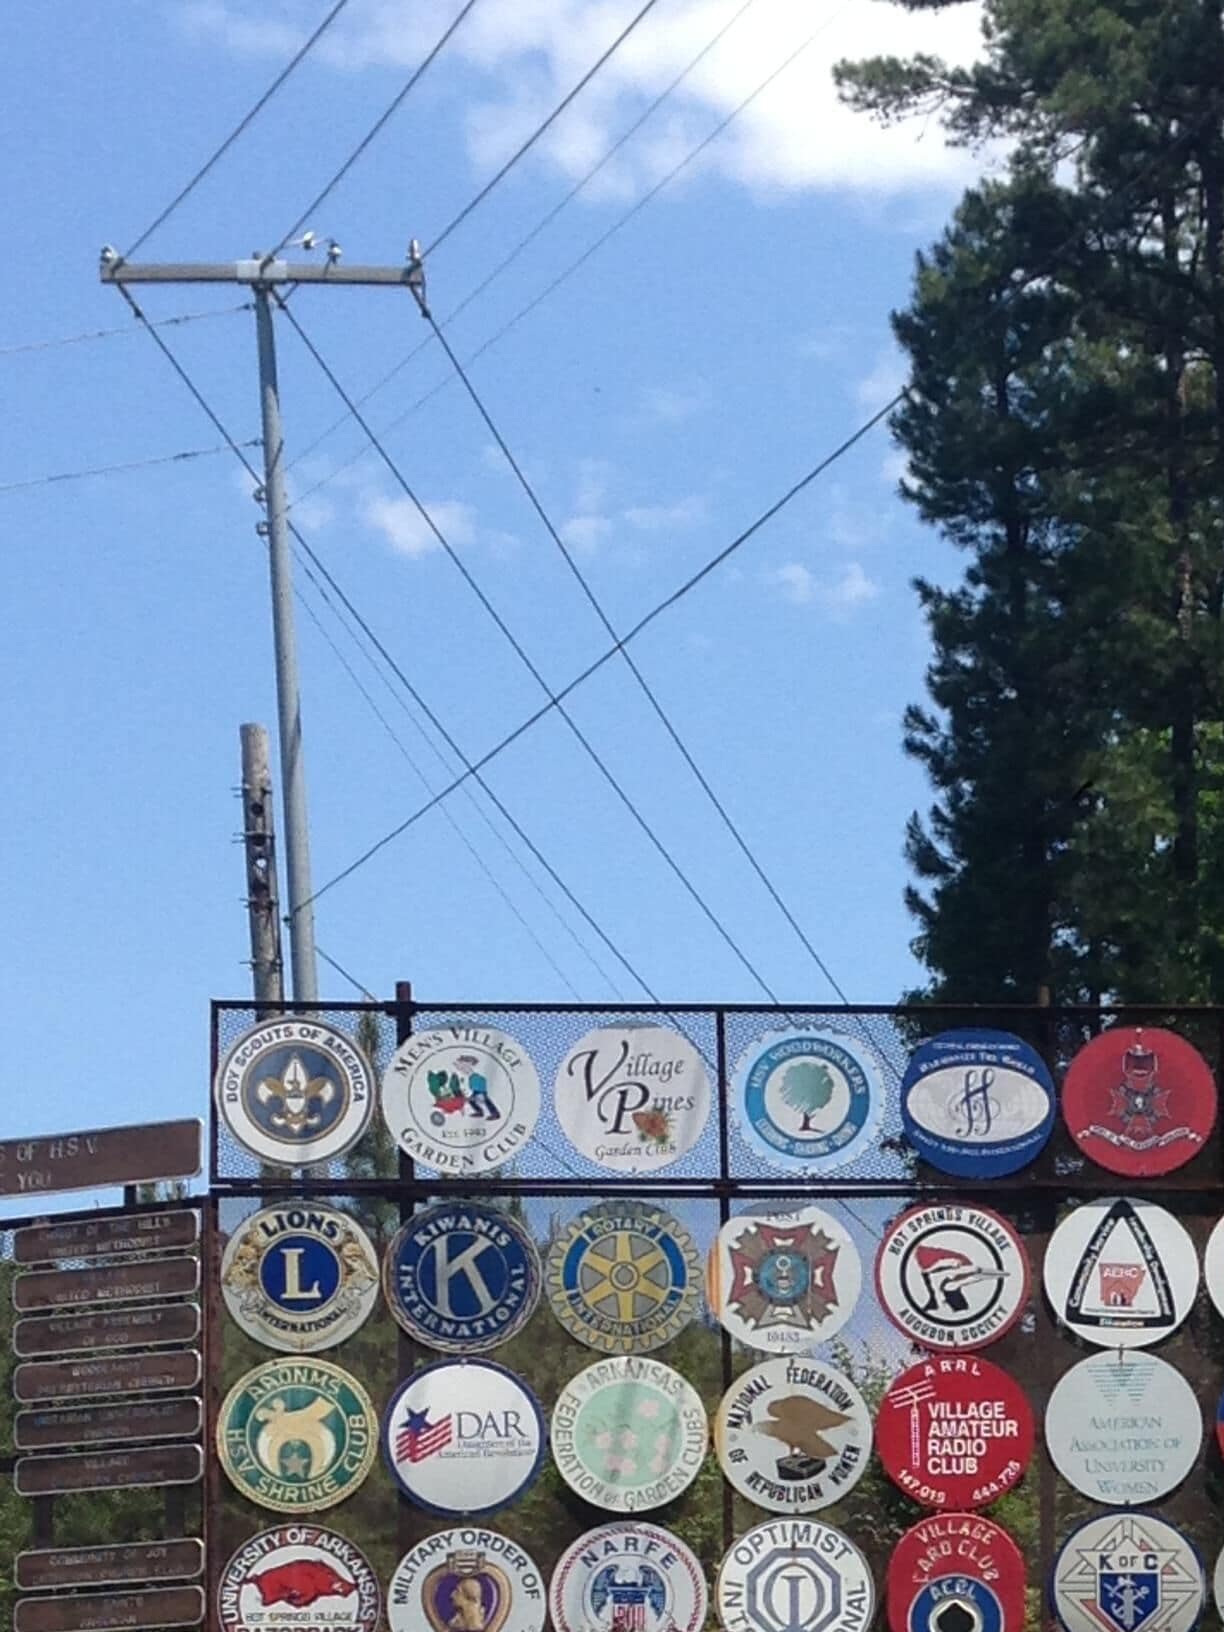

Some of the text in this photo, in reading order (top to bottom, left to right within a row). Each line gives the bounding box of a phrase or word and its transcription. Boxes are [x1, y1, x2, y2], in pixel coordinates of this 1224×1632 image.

[234, 1024, 294, 1065] SCOUTS
[299, 1025, 320, 1040] OF
[322, 1029, 365, 1103] AMERICA
[450, 1025, 523, 1069] VILLAGE
[567, 1040, 684, 1102] Village
[597, 1081, 695, 1135] Pines
[401, 1123, 526, 1168] GARDEN CLUB
[259, 1211, 340, 1239] LIONS
[415, 1217, 510, 1247] KIWANIS
[593, 1216, 651, 1237] ROTARY
[889, 1207, 1011, 1255] HOT SPRINGS VILLAGE
[280, 1247, 322, 1300] L
[433, 1243, 493, 1316] K
[400, 1264, 524, 1337] INTERNATIONAL
[899, 1307, 1008, 1342] AUDUBON SOCIETY
[586, 1361, 684, 1396] ARKANSAS
[924, 1359, 981, 1376] ARRL
[727, 1364, 854, 1430] NATIONAL FEDERATION
[928, 1402, 1006, 1419] VILLAGE
[457, 1410, 527, 1440] DAR
[928, 1420, 1018, 1437] AMATEUR
[1089, 1416, 1162, 1430] AMERICAN
[228, 1413, 368, 1503] HSV SHRINE CLUB
[555, 1391, 607, 1500] FEDERATION
[624, 1468, 691, 1507] GARDEN
[681, 1407, 705, 1467] CLUBS
[928, 1438, 987, 1456] RADIO
[1070, 1438, 1182, 1451] ASSOCIATION OF
[727, 1443, 862, 1504] OF REPUBLICAN WOMEN
[928, 1456, 978, 1474] CLUB
[1084, 1459, 1167, 1474] UNIVERSITY
[1096, 1480, 1159, 1494] WOMEN
[735, 1522, 853, 1566] OPTIMIST
[916, 1520, 998, 1544] VILLAGE
[393, 1530, 541, 1606] MILITARY ORDER OF
[580, 1537, 679, 1571] NARFE
[912, 1539, 1000, 1584] CARD CLUB
[1099, 1553, 1159, 1570] K C
[222, 1527, 377, 1625] UNIVERSITY OF ARKANSAS
